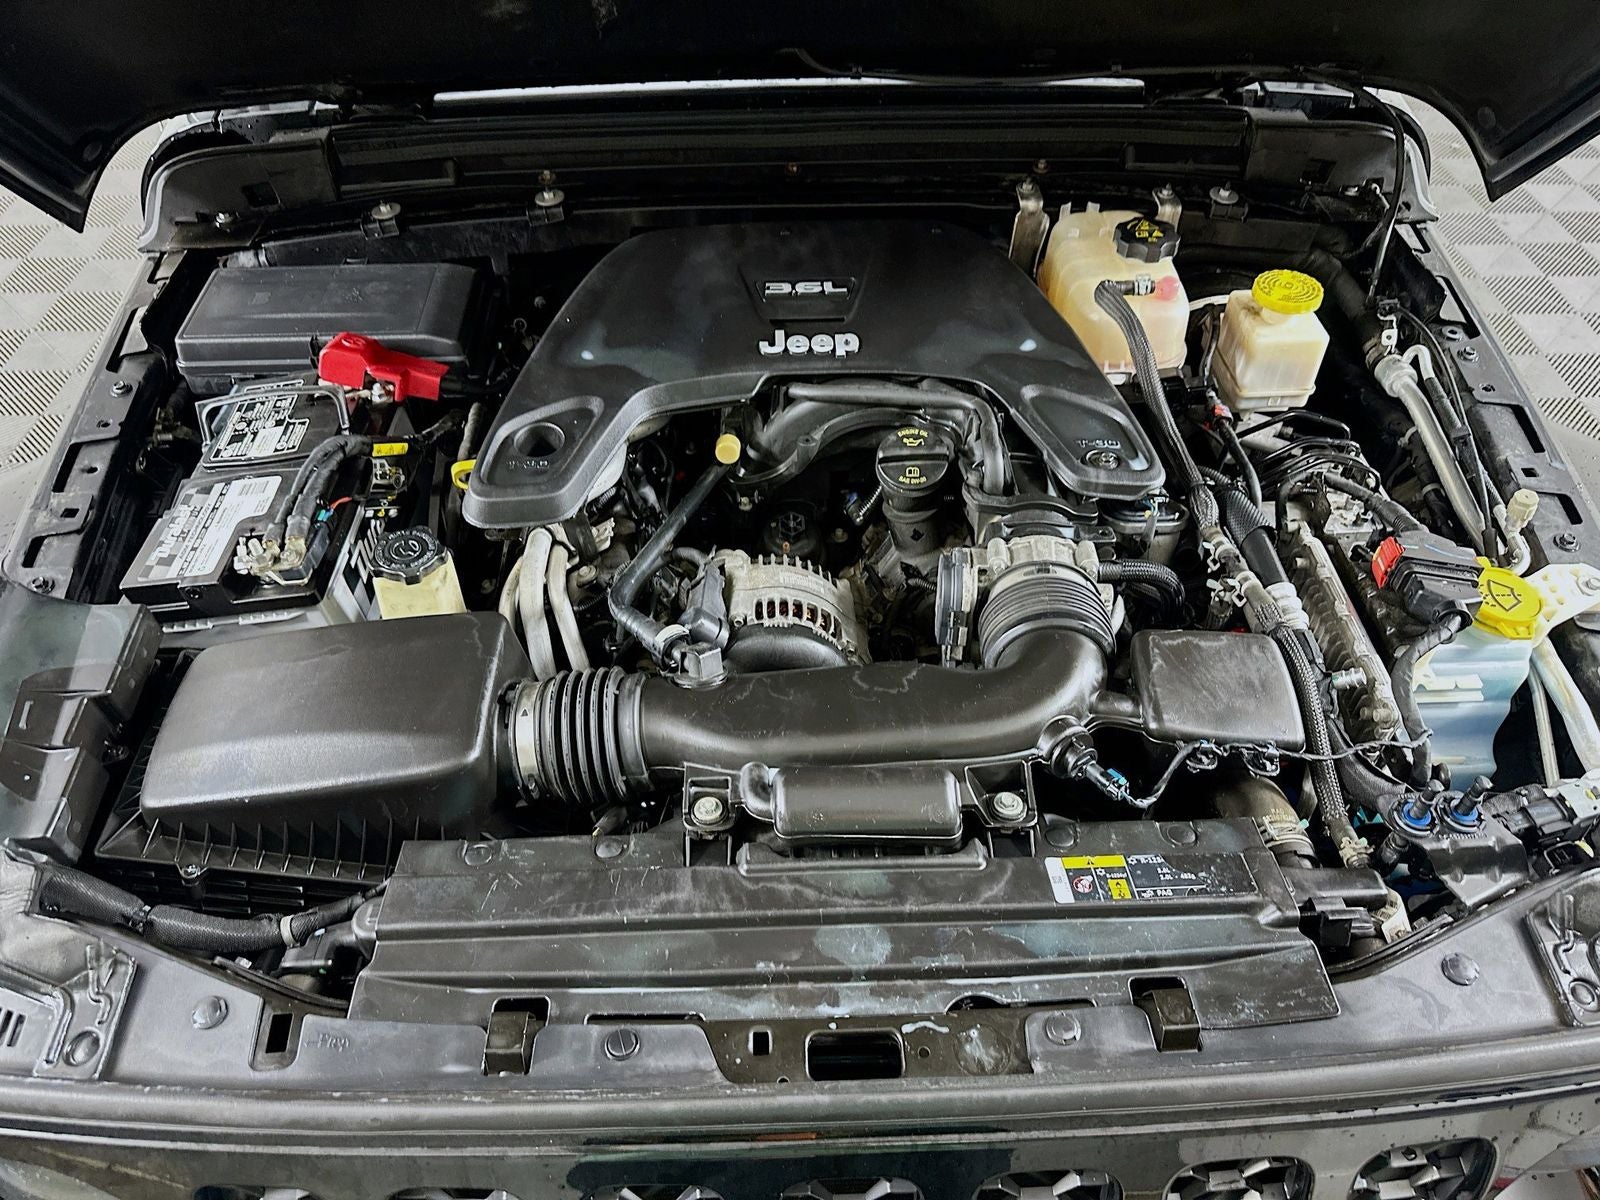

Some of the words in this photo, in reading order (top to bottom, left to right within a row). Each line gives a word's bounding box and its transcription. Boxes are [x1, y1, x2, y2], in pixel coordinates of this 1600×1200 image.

[765, 281, 847, 295] 3.6L
[759, 329, 859, 358] Jeep
[897, 429, 919, 437] ENGINE
[920, 429, 928, 438] OIL
[1156, 889, 1173, 897] PAG
